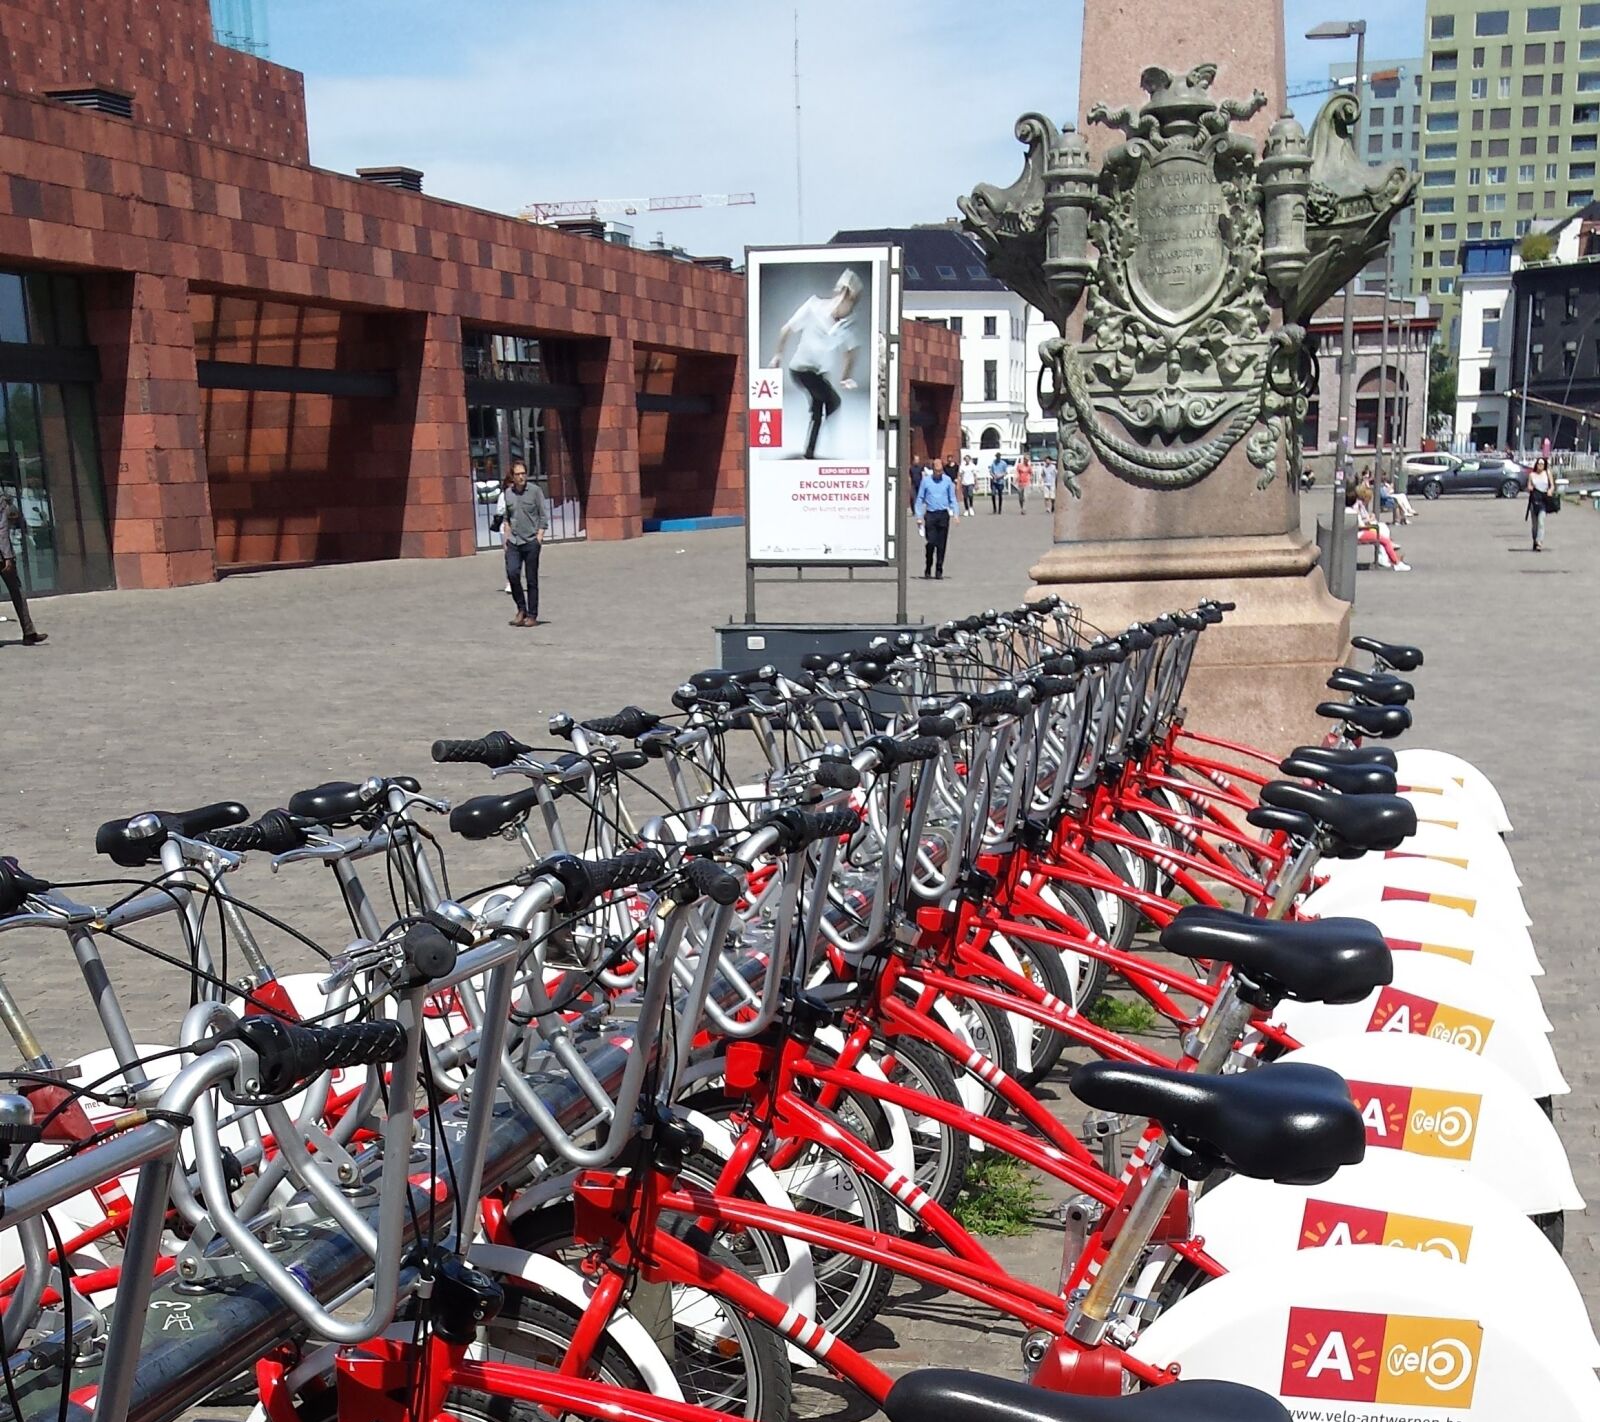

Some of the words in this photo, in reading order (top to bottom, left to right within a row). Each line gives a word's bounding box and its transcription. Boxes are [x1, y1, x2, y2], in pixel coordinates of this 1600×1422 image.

[757, 379, 773, 398] A
[758, 410, 772, 446] MAS
[791, 493, 870, 501] ONTMOETINGEN
[800, 480, 870, 489] ENCOUNTERS/
[1361, 1097, 1388, 1137] A
[1306, 1330, 1354, 1381] A
